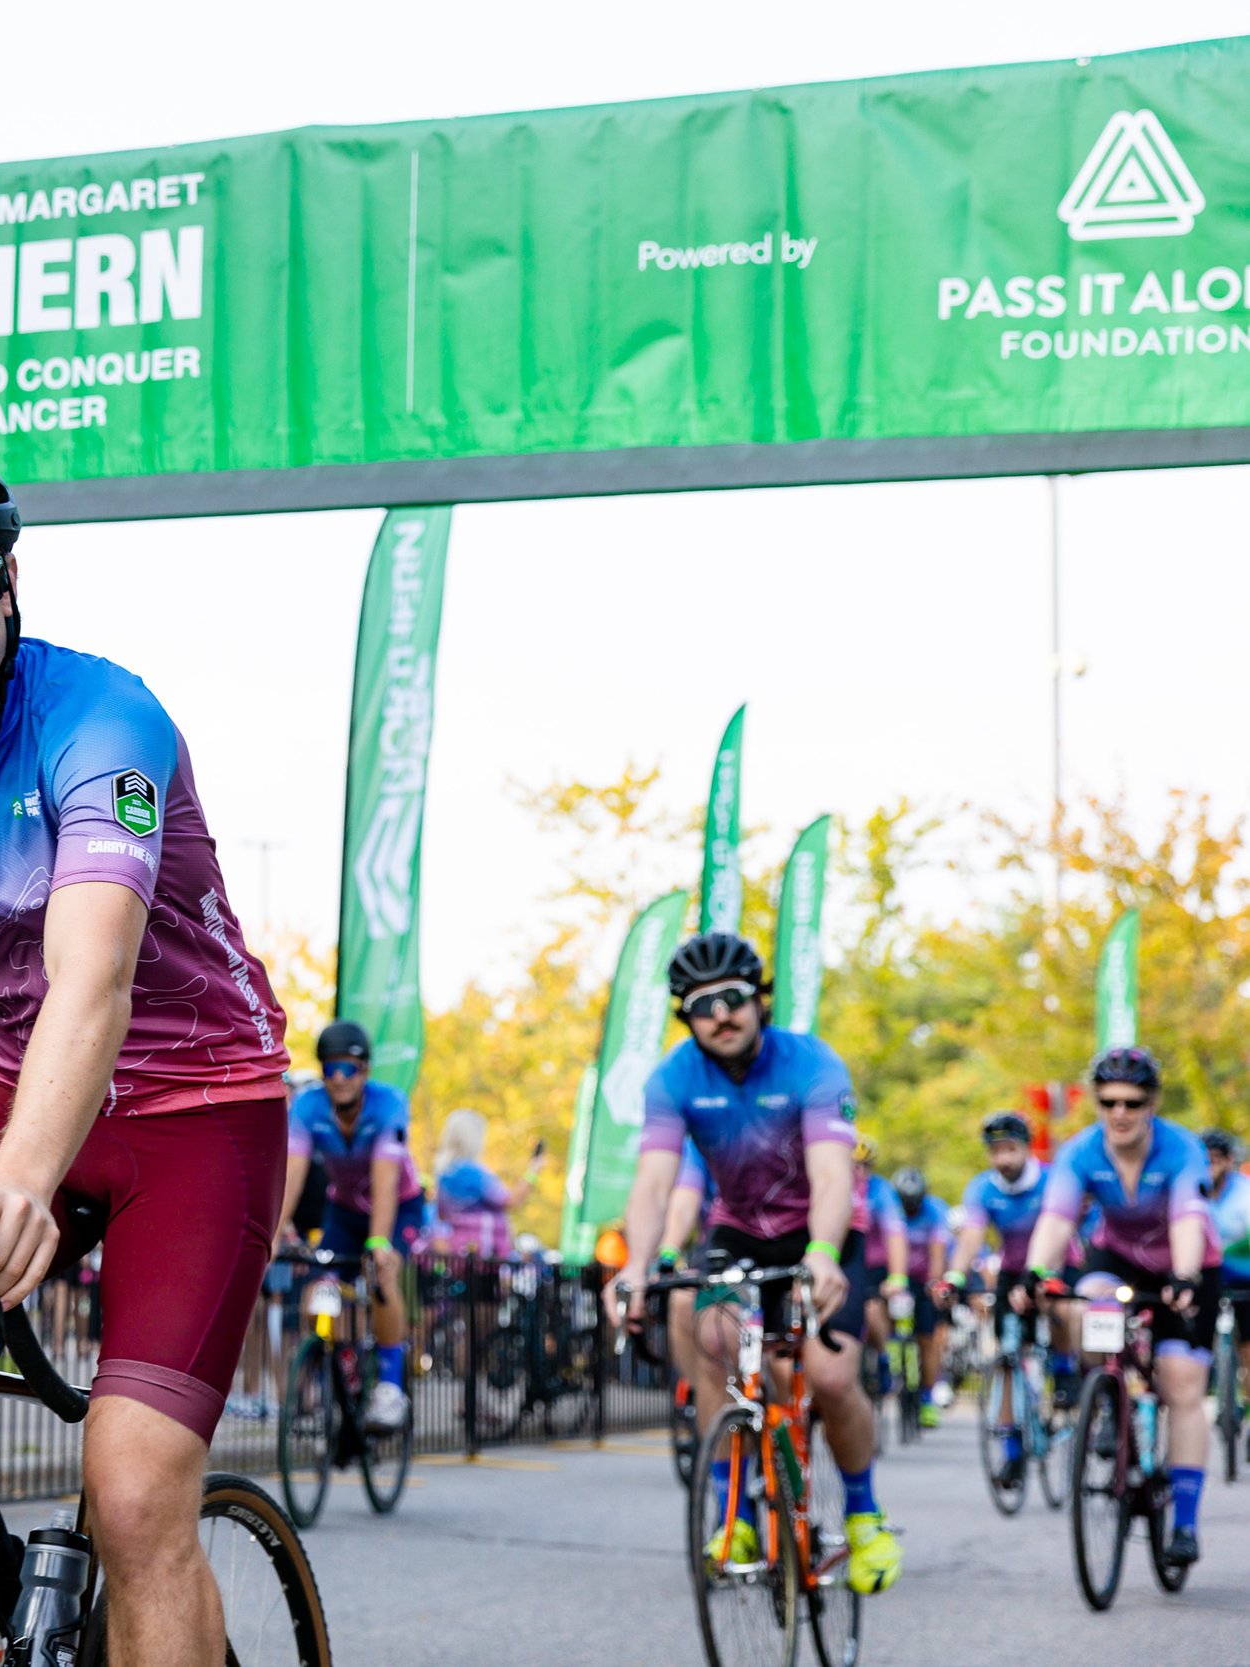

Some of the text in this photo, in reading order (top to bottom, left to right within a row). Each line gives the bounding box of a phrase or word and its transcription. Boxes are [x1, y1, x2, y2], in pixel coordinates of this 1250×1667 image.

[639, 231, 818, 271] Powered by
[938, 264, 1250, 320] PASS IT ALO
[1001, 324, 1250, 360] FOUNDATION
[16, 346, 200, 391] CONQUER
[87, 840, 127, 854] CARRY
[128, 844, 147, 862] THE
[231, 963, 260, 1012] PASS
[251, 1007, 276, 1055] 2025
[227, 1505, 282, 1547] ALEXRIMS
